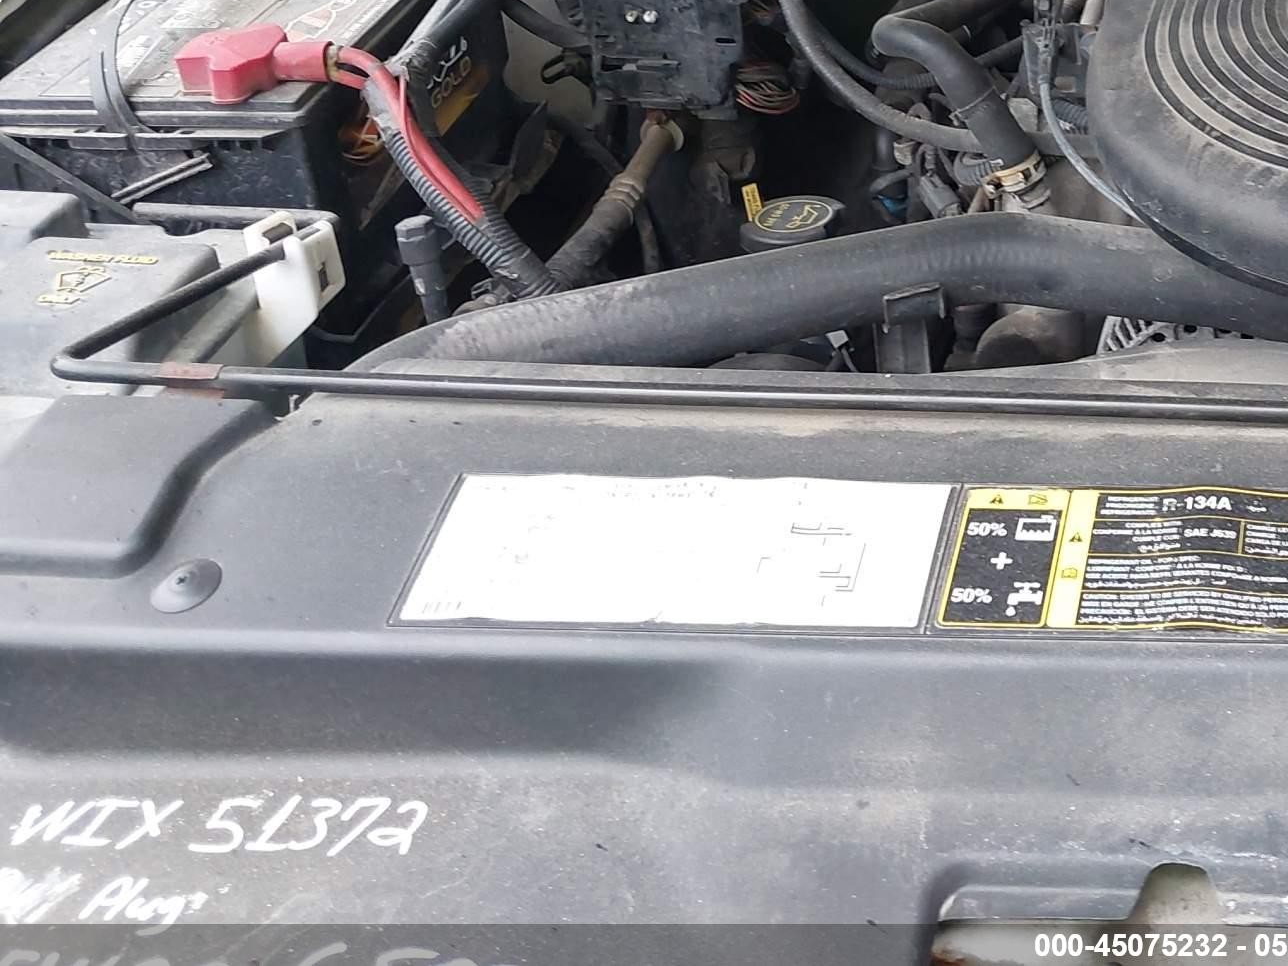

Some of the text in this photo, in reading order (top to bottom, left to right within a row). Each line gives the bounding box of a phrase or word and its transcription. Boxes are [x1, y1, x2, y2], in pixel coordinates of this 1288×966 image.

[1162, 495, 1233, 512] R-134A
[967, 521, 1008, 537] 50%
[1183, 528, 1209, 538] SAE
[950, 587, 993, 603] 50%
[10, 799, 184, 849] WIX
